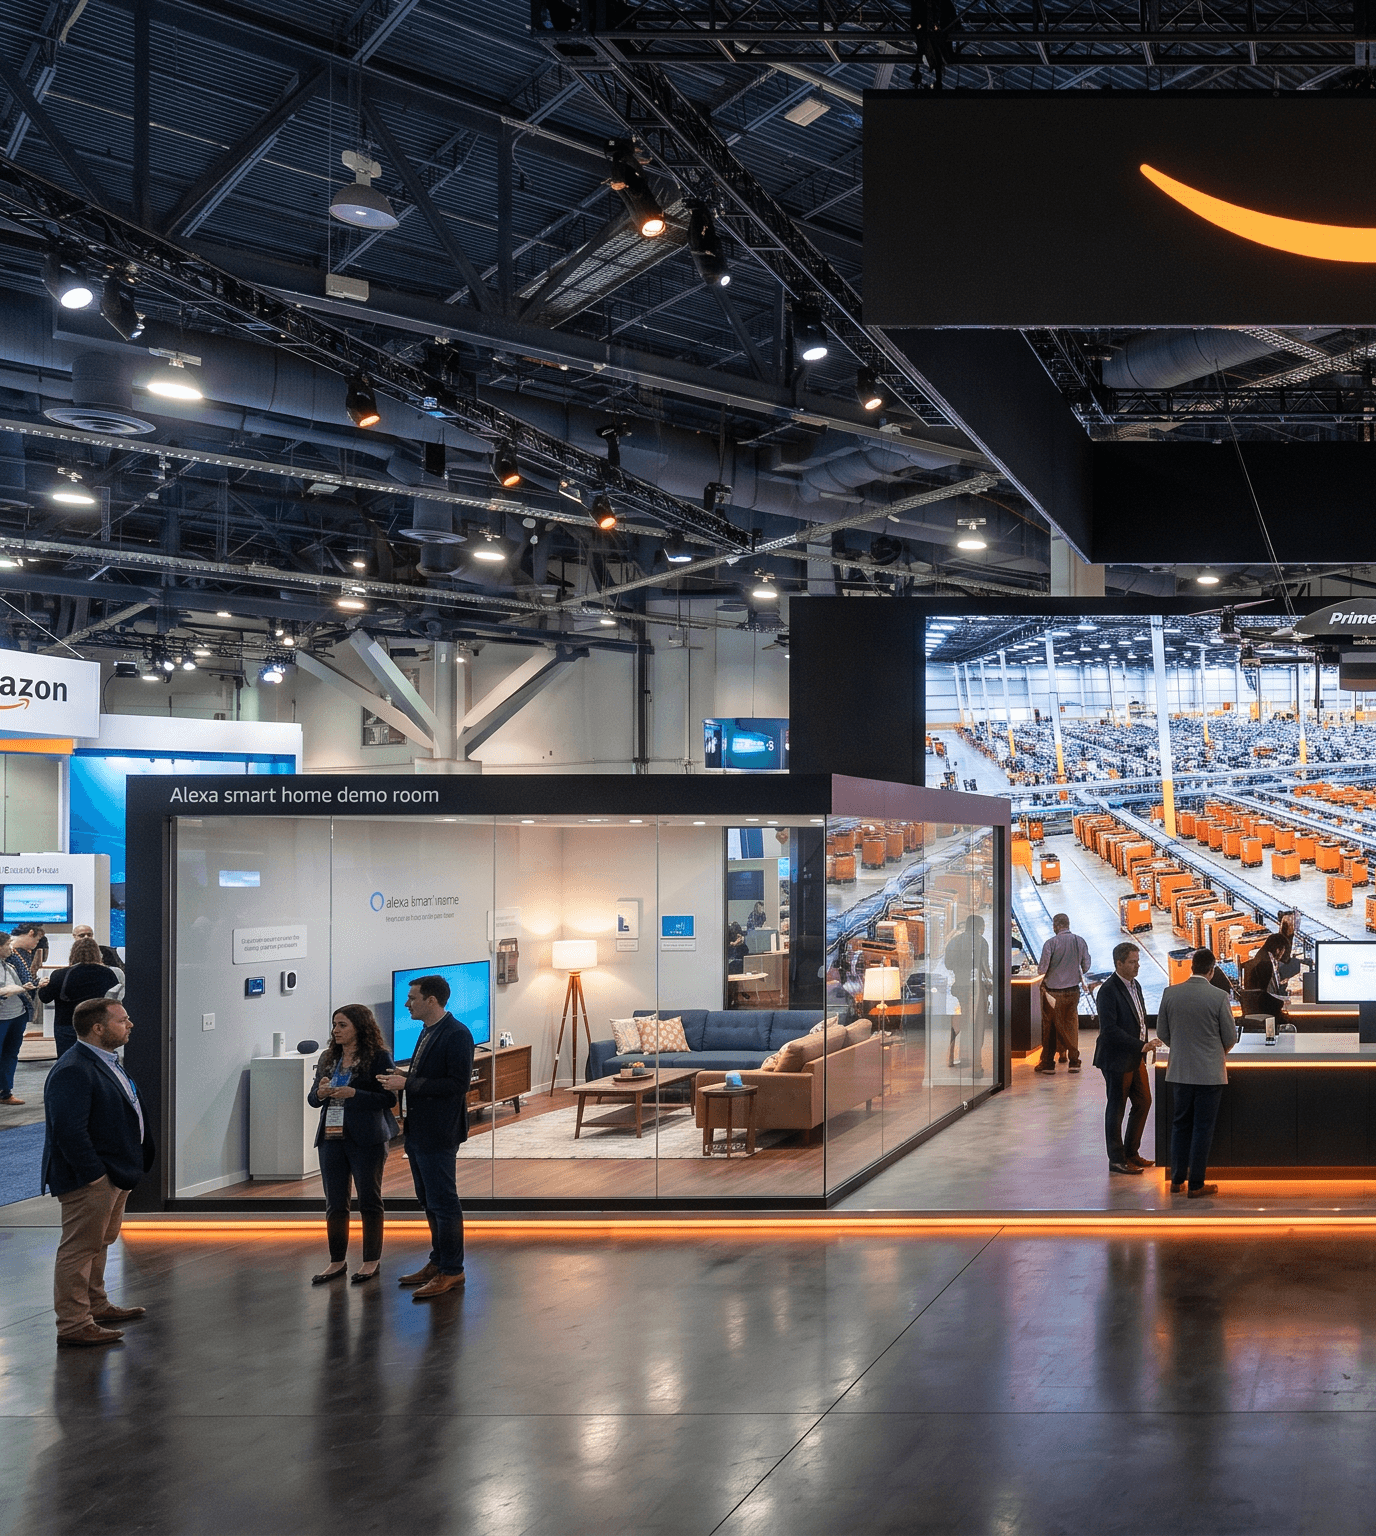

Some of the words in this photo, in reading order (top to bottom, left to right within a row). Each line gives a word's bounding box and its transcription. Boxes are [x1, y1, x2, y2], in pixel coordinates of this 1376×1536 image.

[1329, 611, 1376, 625] Prime
[170, 787, 218, 803] Alexa
[224, 788, 276, 803] smart
[282, 787, 332, 803] home
[337, 787, 387, 803] demo
[393, 790, 439, 803] room
[386, 896, 409, 909] alexa
